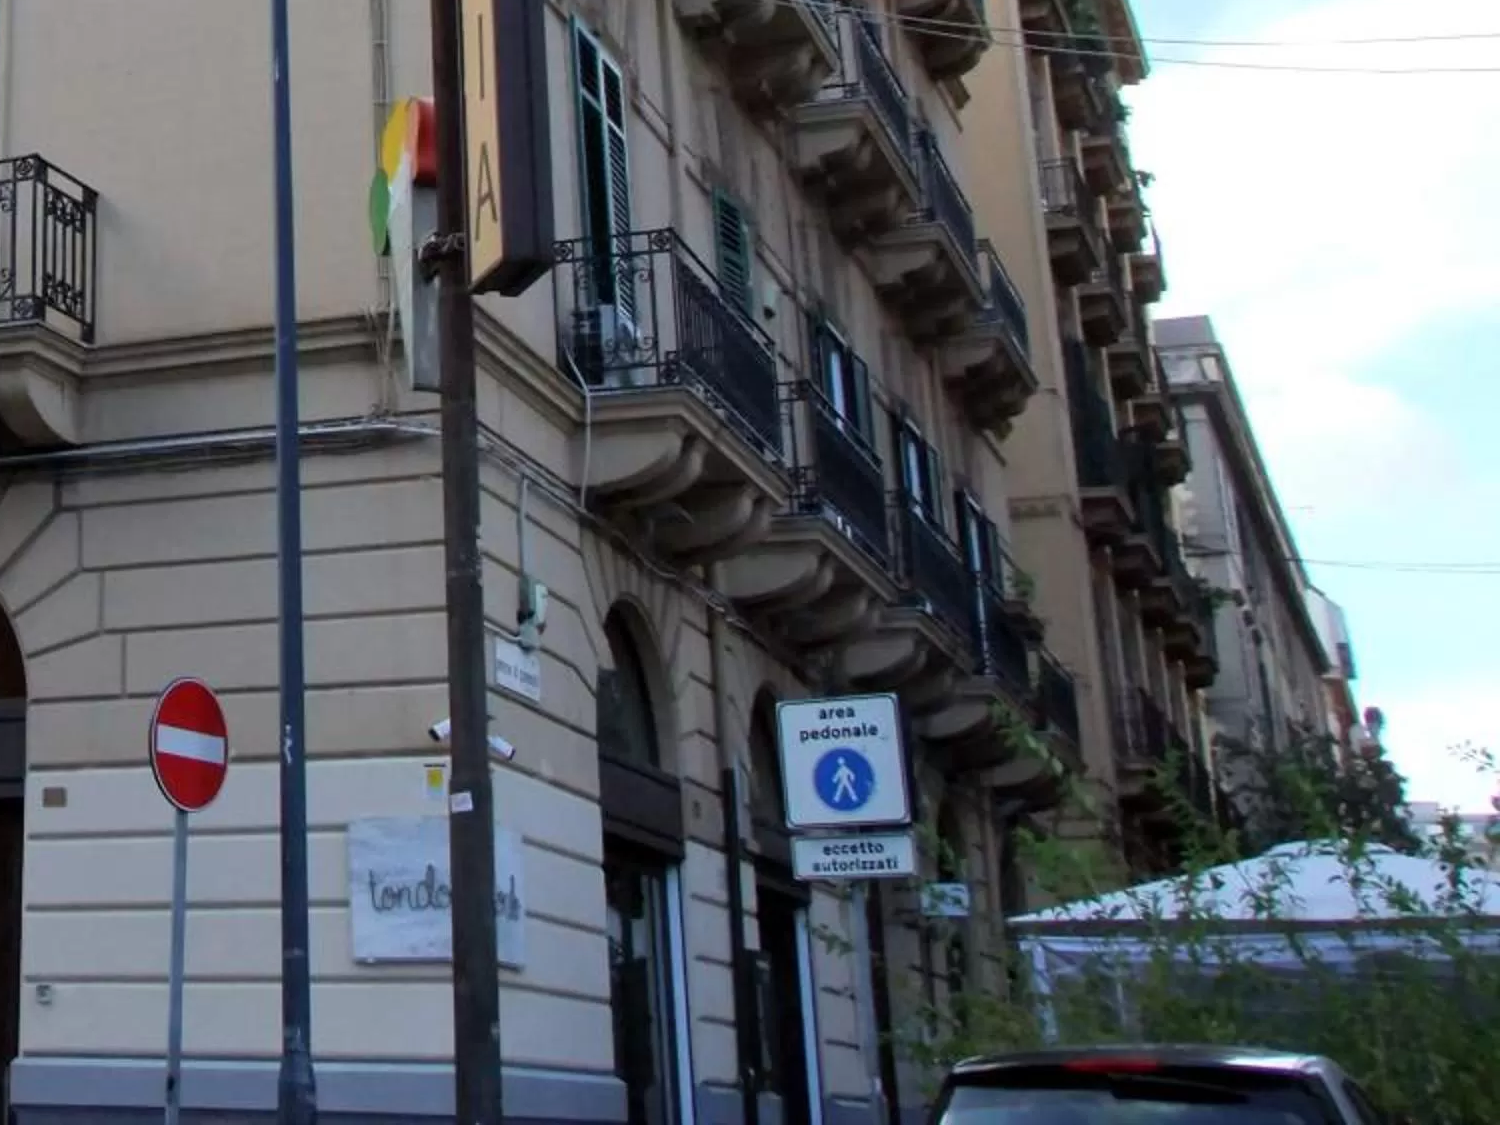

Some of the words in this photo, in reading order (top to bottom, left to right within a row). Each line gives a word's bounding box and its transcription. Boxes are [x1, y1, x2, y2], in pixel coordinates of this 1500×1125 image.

[819, 707, 855, 720] area
[800, 723, 878, 742] pedonale
[822, 841, 884, 856] eccetto
[812, 856, 899, 873] autorizzati
